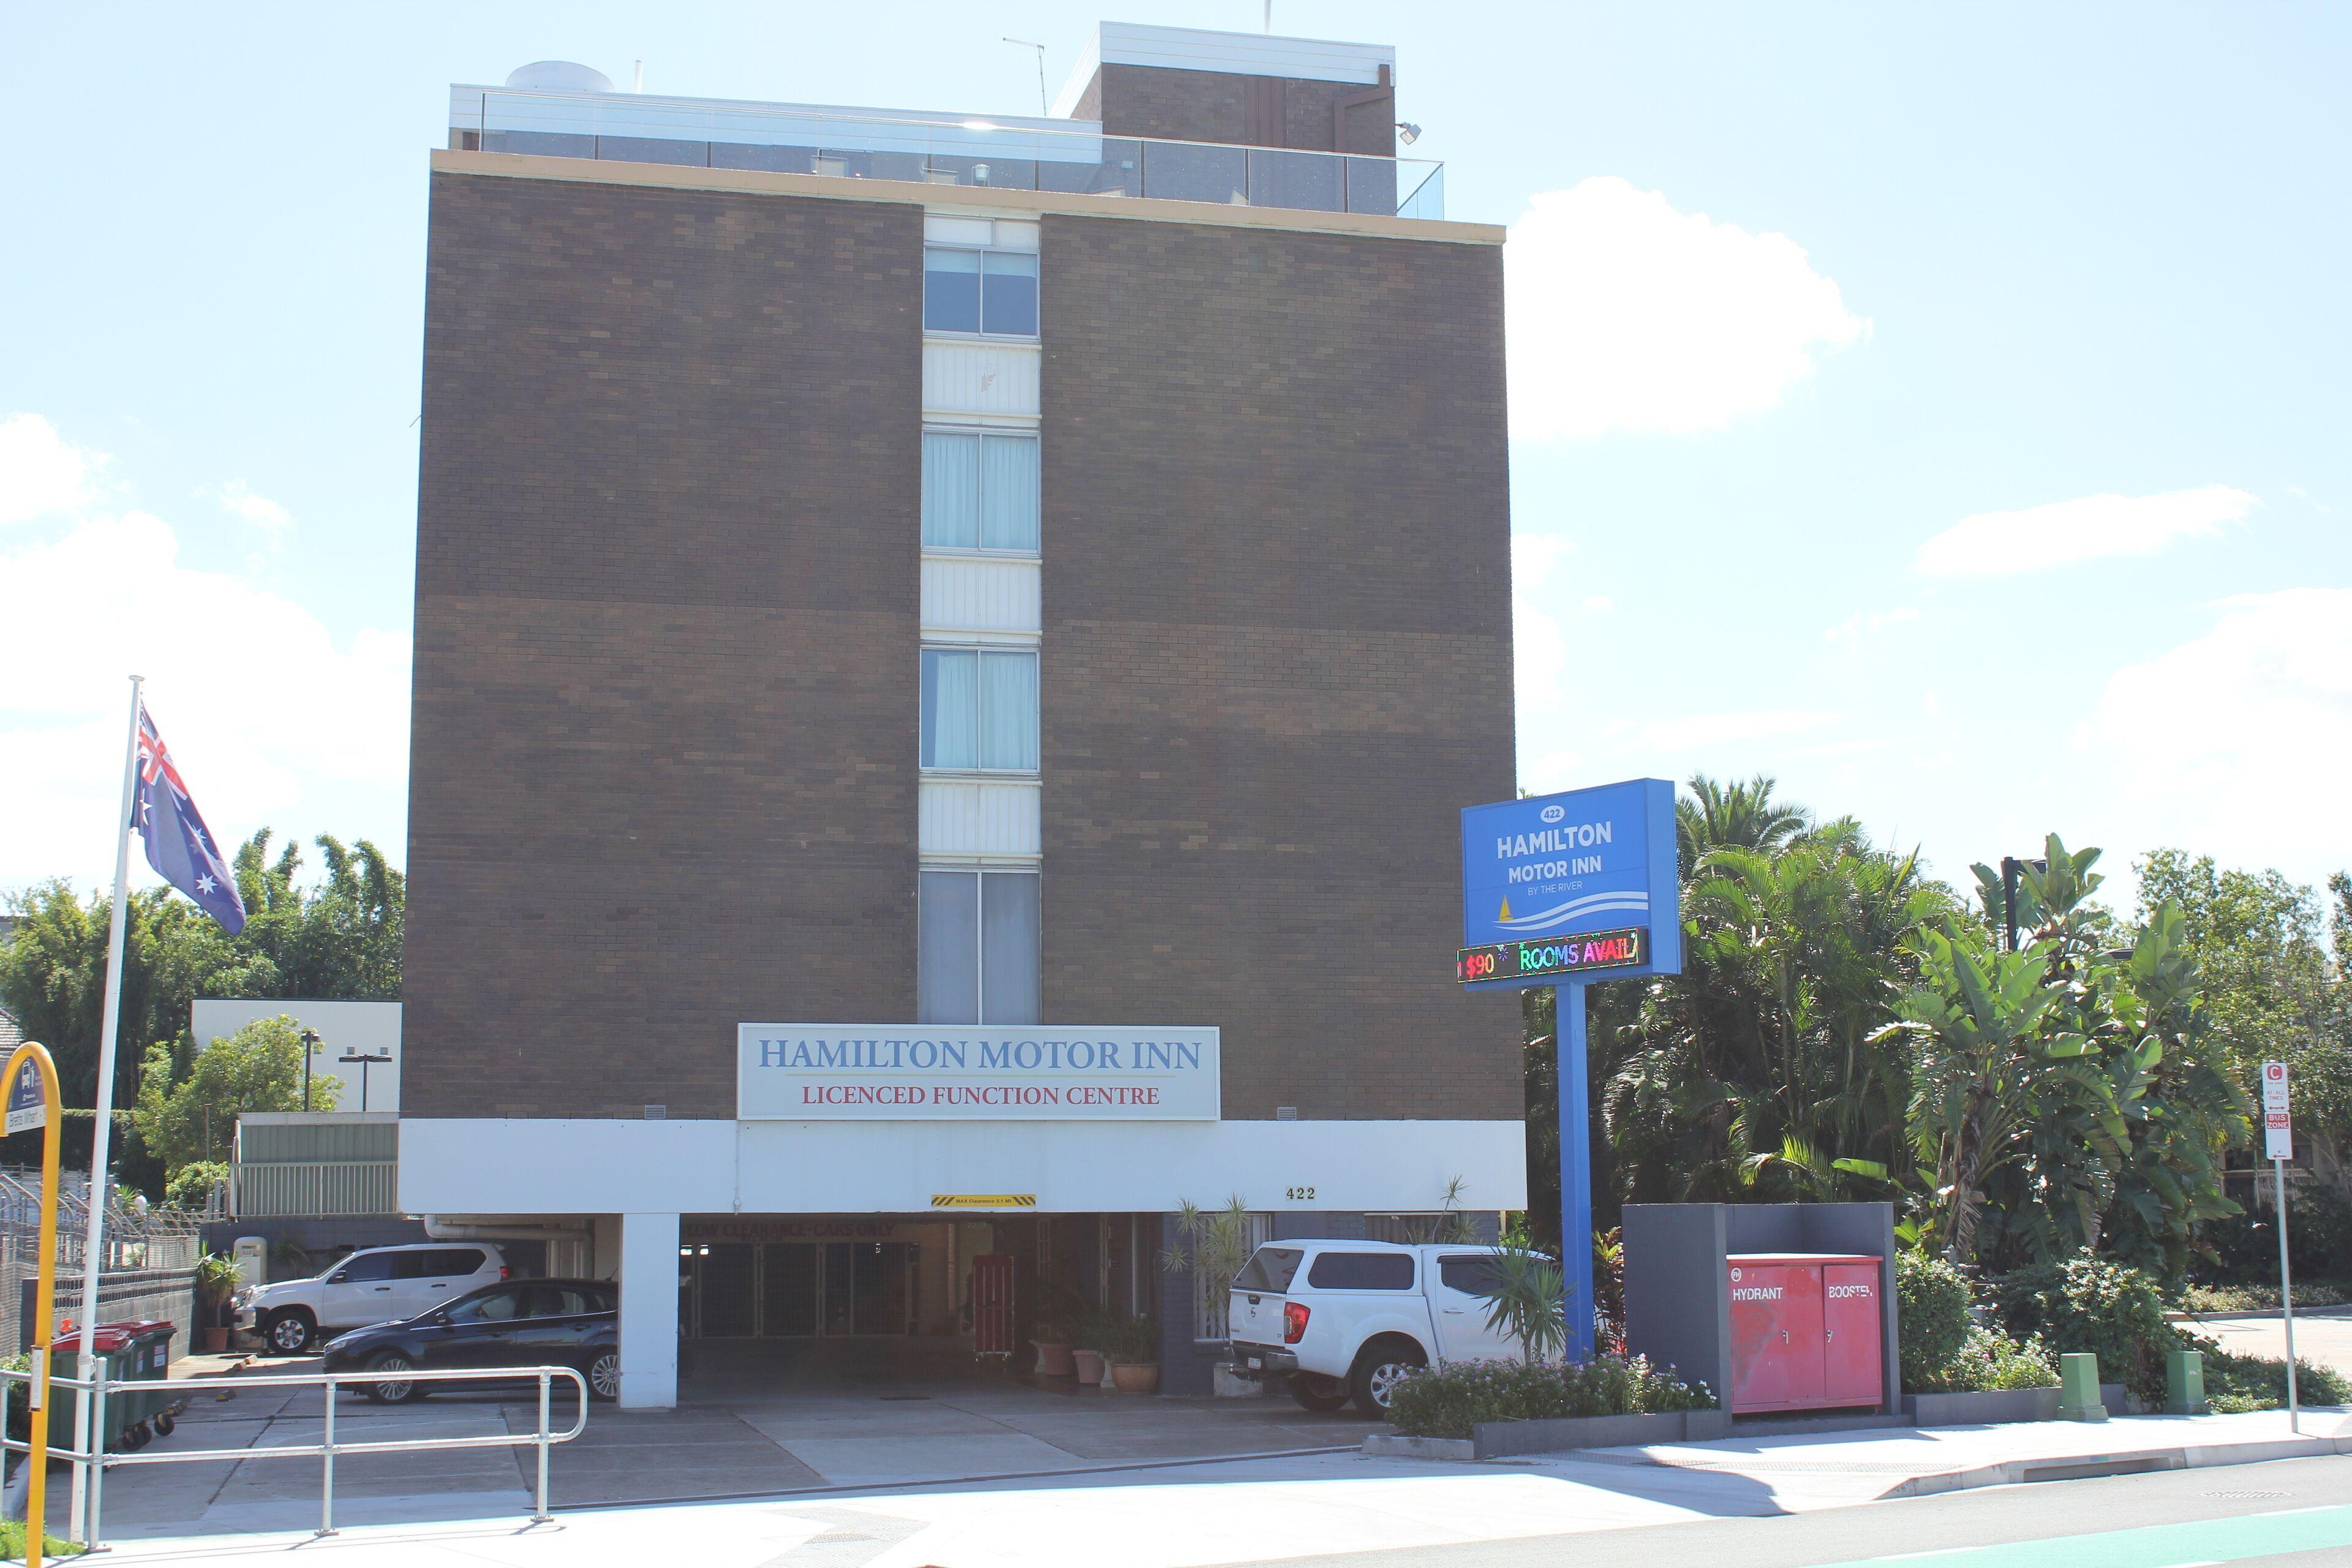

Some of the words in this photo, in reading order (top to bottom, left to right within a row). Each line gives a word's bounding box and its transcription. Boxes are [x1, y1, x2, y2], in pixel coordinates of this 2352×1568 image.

[1544, 809, 1561, 819] 422
[1497, 821, 1612, 859] HAMILTON
[1509, 860, 1568, 884] MOTOR
[1572, 855, 1602, 876] INN
[1528, 886, 1539, 896] BY
[1540, 884, 1556, 894] THE
[1558, 881, 1583, 892] RIVER
[1466, 952, 1494, 979] $90
[1520, 943, 1580, 971] ROOMS
[759, 1039, 968, 1069] HAMILTON
[978, 1041, 1123, 1069] MOTOR
[1131, 1041, 1202, 1069] INN
[802, 1085, 926, 1104] LICENCED
[932, 1087, 1060, 1105] FUNCTION
[1066, 1087, 1160, 1105] CENTRE
[1286, 1188, 1315, 1199] 422
[856, 1224, 895, 1237] ONLY
[1733, 1287, 1784, 1301] HYDRANT
